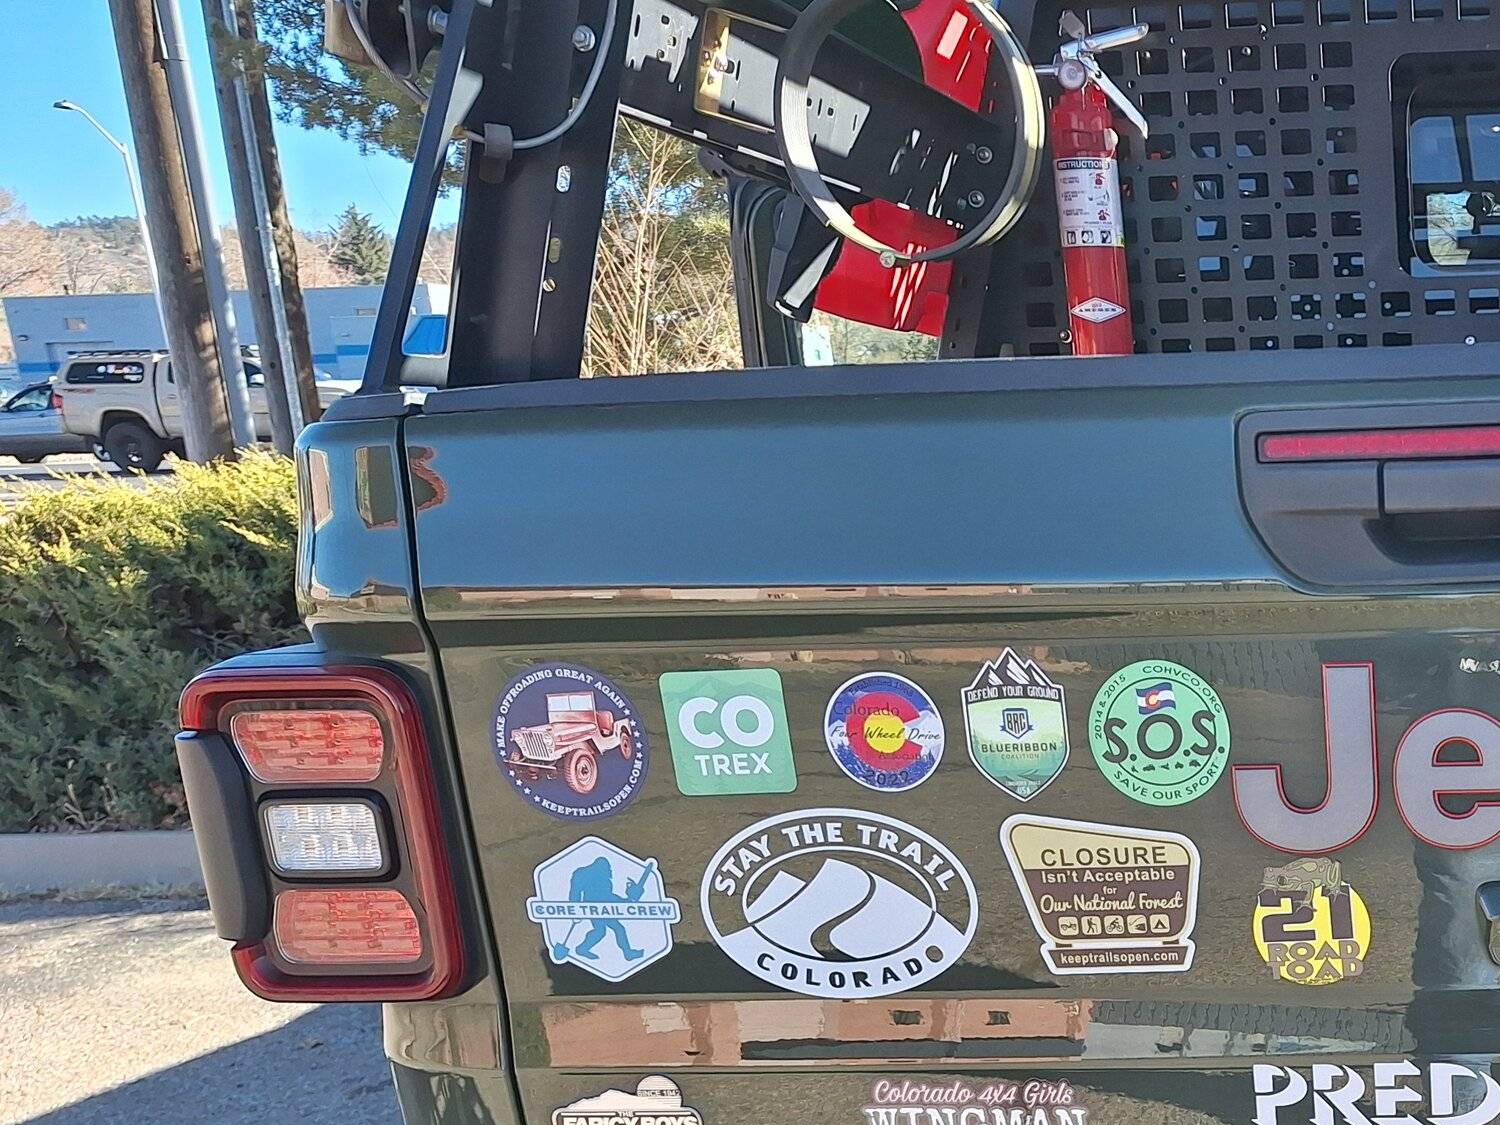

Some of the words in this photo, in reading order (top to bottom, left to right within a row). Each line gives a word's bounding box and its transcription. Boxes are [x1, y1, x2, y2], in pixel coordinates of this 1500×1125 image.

[968, 687, 998, 702] DEFEND
[1002, 686, 1024, 697] YOUR
[1027, 686, 1059, 700] GROUND
[1142, 665, 1223, 714] COHVCO.ORG
[496, 716, 506, 748] MAKE
[501, 669, 552, 714] OFFROADING
[555, 668, 593, 684] GREAT
[594, 681, 626, 709] AGAIN
[833, 701, 900, 716] Colorado
[1094, 710, 1104, 740] 2014
[1104, 674, 1126, 698] 2015
[678, 695, 774, 748] CO
[1006, 712, 1026, 734] BRC
[830, 726, 858, 739] Four
[865, 727, 906, 740] Wheel
[908, 728, 941, 740] Drive
[982, 742, 1057, 752] BLUERIBBON
[694, 752, 772, 776] TREX
[542, 760, 643, 816] KEEPTRAILSOPEN.COM
[1114, 770, 1148, 797] SAVE
[1152, 790, 1182, 800] OUR
[1186, 763, 1219, 794] SPORT
[714, 834, 772, 896] STAY
[781, 822, 844, 847] THE
[856, 824, 957, 892] TRAIL
[1041, 846, 1168, 867] CLOSURE
[1042, 870, 1078, 884] Isn't
[1083, 868, 1175, 884] Acceptable
[1102, 885, 1118, 895] for
[536, 905, 576, 916] CORE
[581, 905, 624, 916] TRAIL
[626, 905, 672, 916] CREW
[1040, 894, 1072, 914] Our
[1074, 892, 1136, 912] National
[1138, 891, 1184, 910] Forest
[1260, 886, 1354, 942] 21
[1061, 952, 1179, 966] keeptrailsopen.com
[1268, 940, 1360, 962] ROAD
[756, 945, 944, 988] COLORADO
[1267, 960, 1364, 980] TOAD
[874, 1080, 974, 1103] Colorado
[977, 1086, 1017, 1107] 4x4
[1024, 1080, 1073, 1108] Girls
